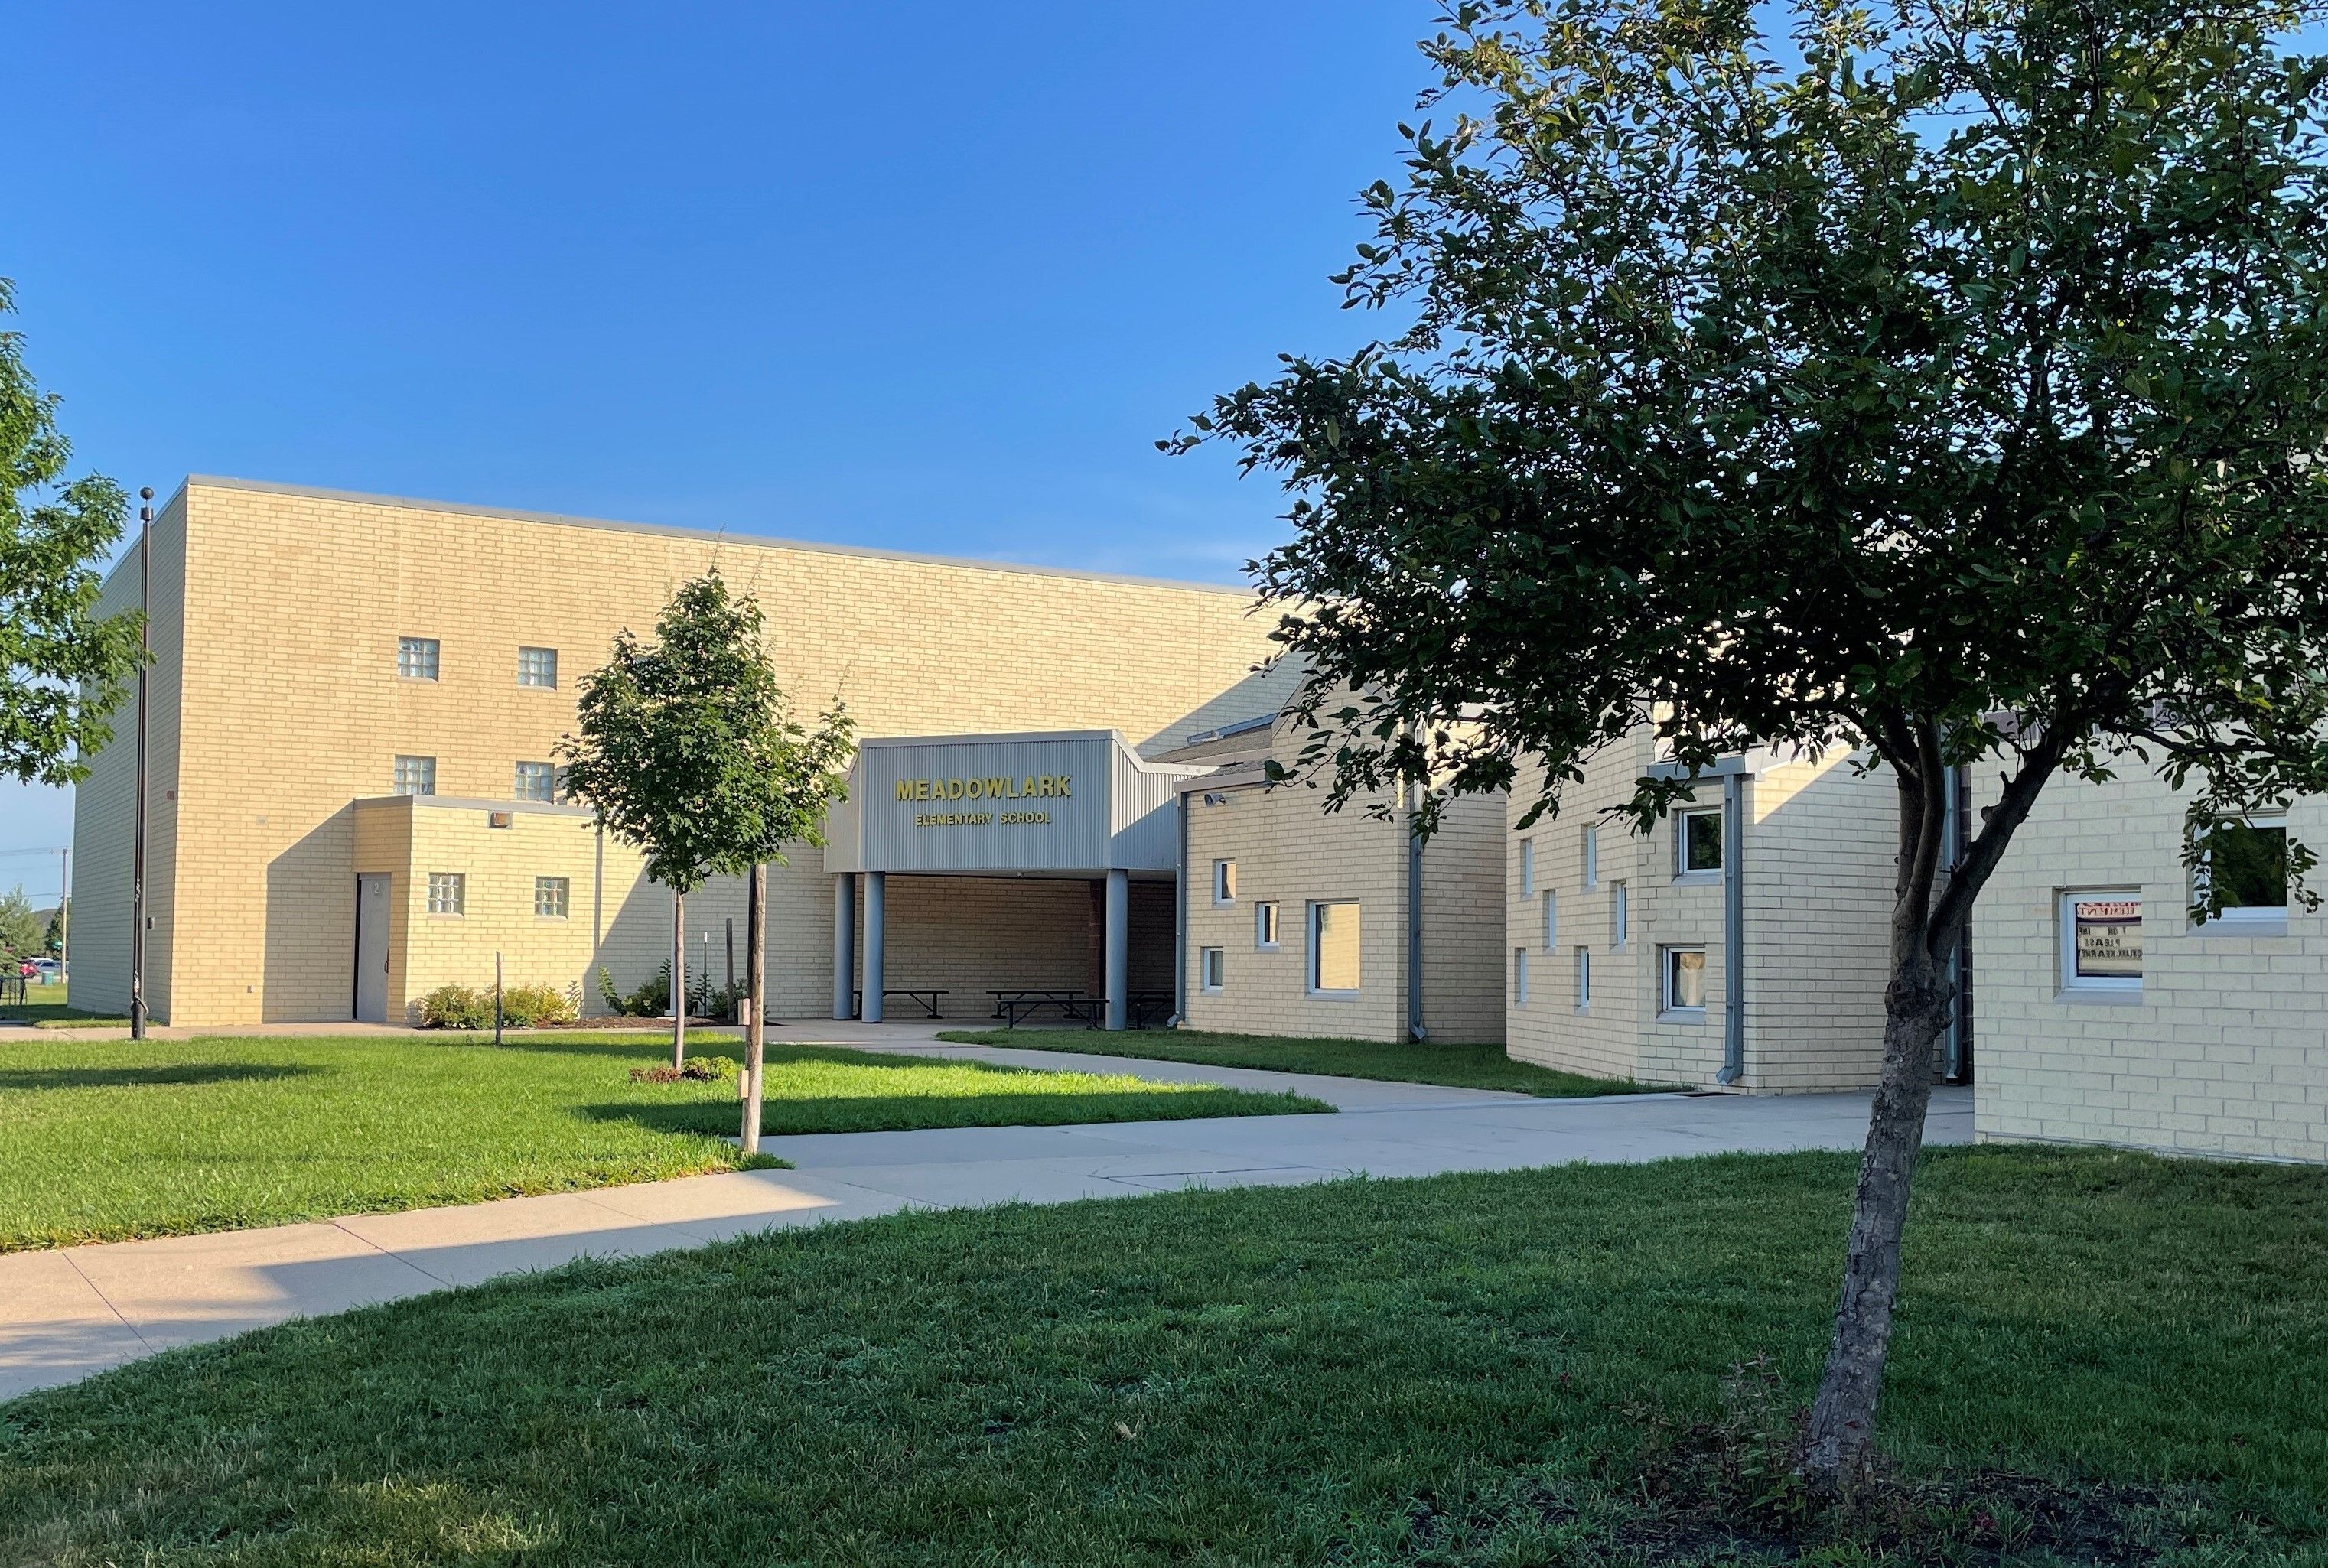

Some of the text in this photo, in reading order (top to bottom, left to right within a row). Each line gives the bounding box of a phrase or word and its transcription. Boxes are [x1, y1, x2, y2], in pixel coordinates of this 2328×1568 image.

[895, 775, 1073, 801] MEADOWLARK
[914, 811, 1053, 826] ELEMENTARY SCHOOL
[374, 883, 379, 893] 2
